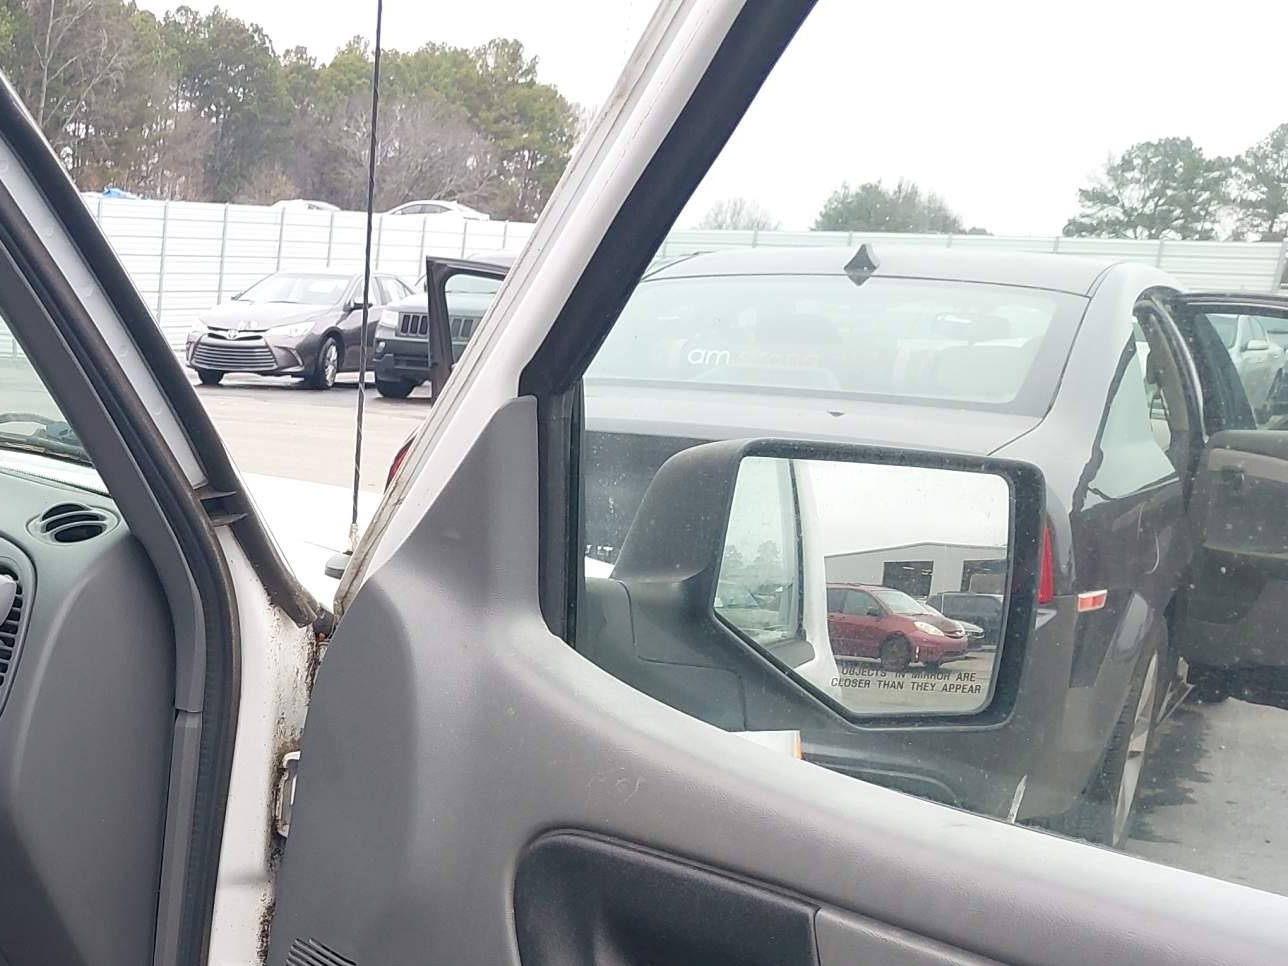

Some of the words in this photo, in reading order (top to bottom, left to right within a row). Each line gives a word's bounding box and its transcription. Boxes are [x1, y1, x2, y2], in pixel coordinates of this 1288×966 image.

[955, 671, 977, 682] ARE
[830, 677, 871, 689] CLOSER
[877, 679, 904, 691] THAN
[911, 681, 937, 692] THEY
[941, 683, 982, 694] APPEAR
